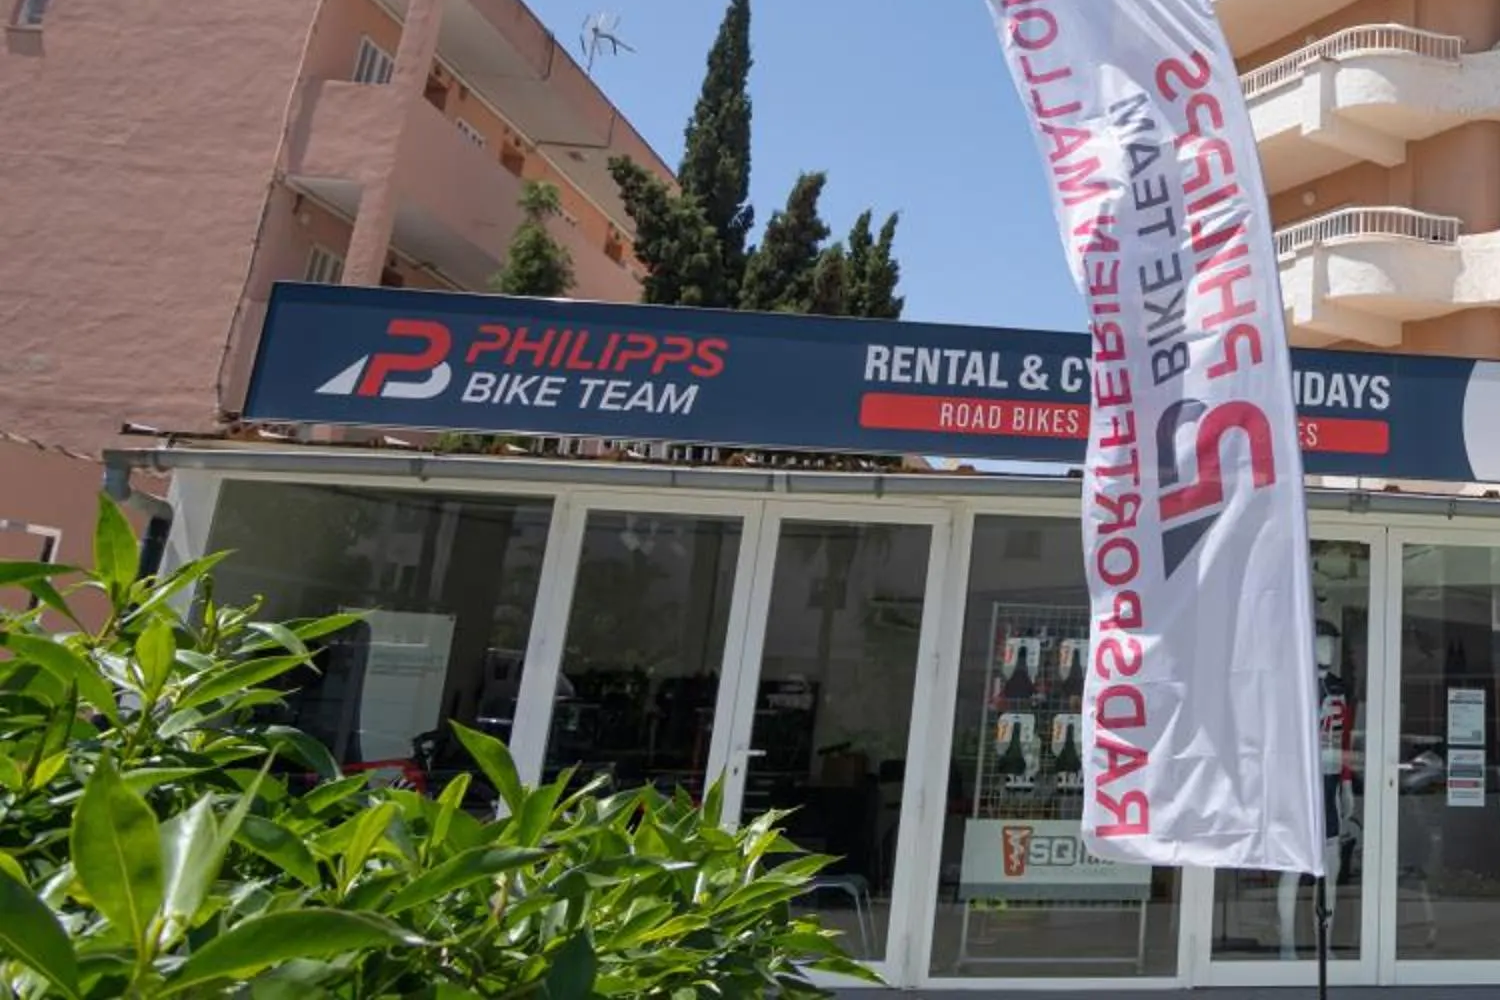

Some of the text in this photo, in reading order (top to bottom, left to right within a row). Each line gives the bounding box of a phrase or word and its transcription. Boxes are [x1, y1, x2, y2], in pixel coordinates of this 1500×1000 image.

[465, 324, 728, 378] PHILIPPS
[863, 344, 1009, 389] RENTAL
[1018, 354, 1050, 391] &
[460, 371, 700, 416] BIKE TEAM
[1292, 369, 1391, 411] IDAYS
[940, 402, 1080, 435] ROAD BIKES
